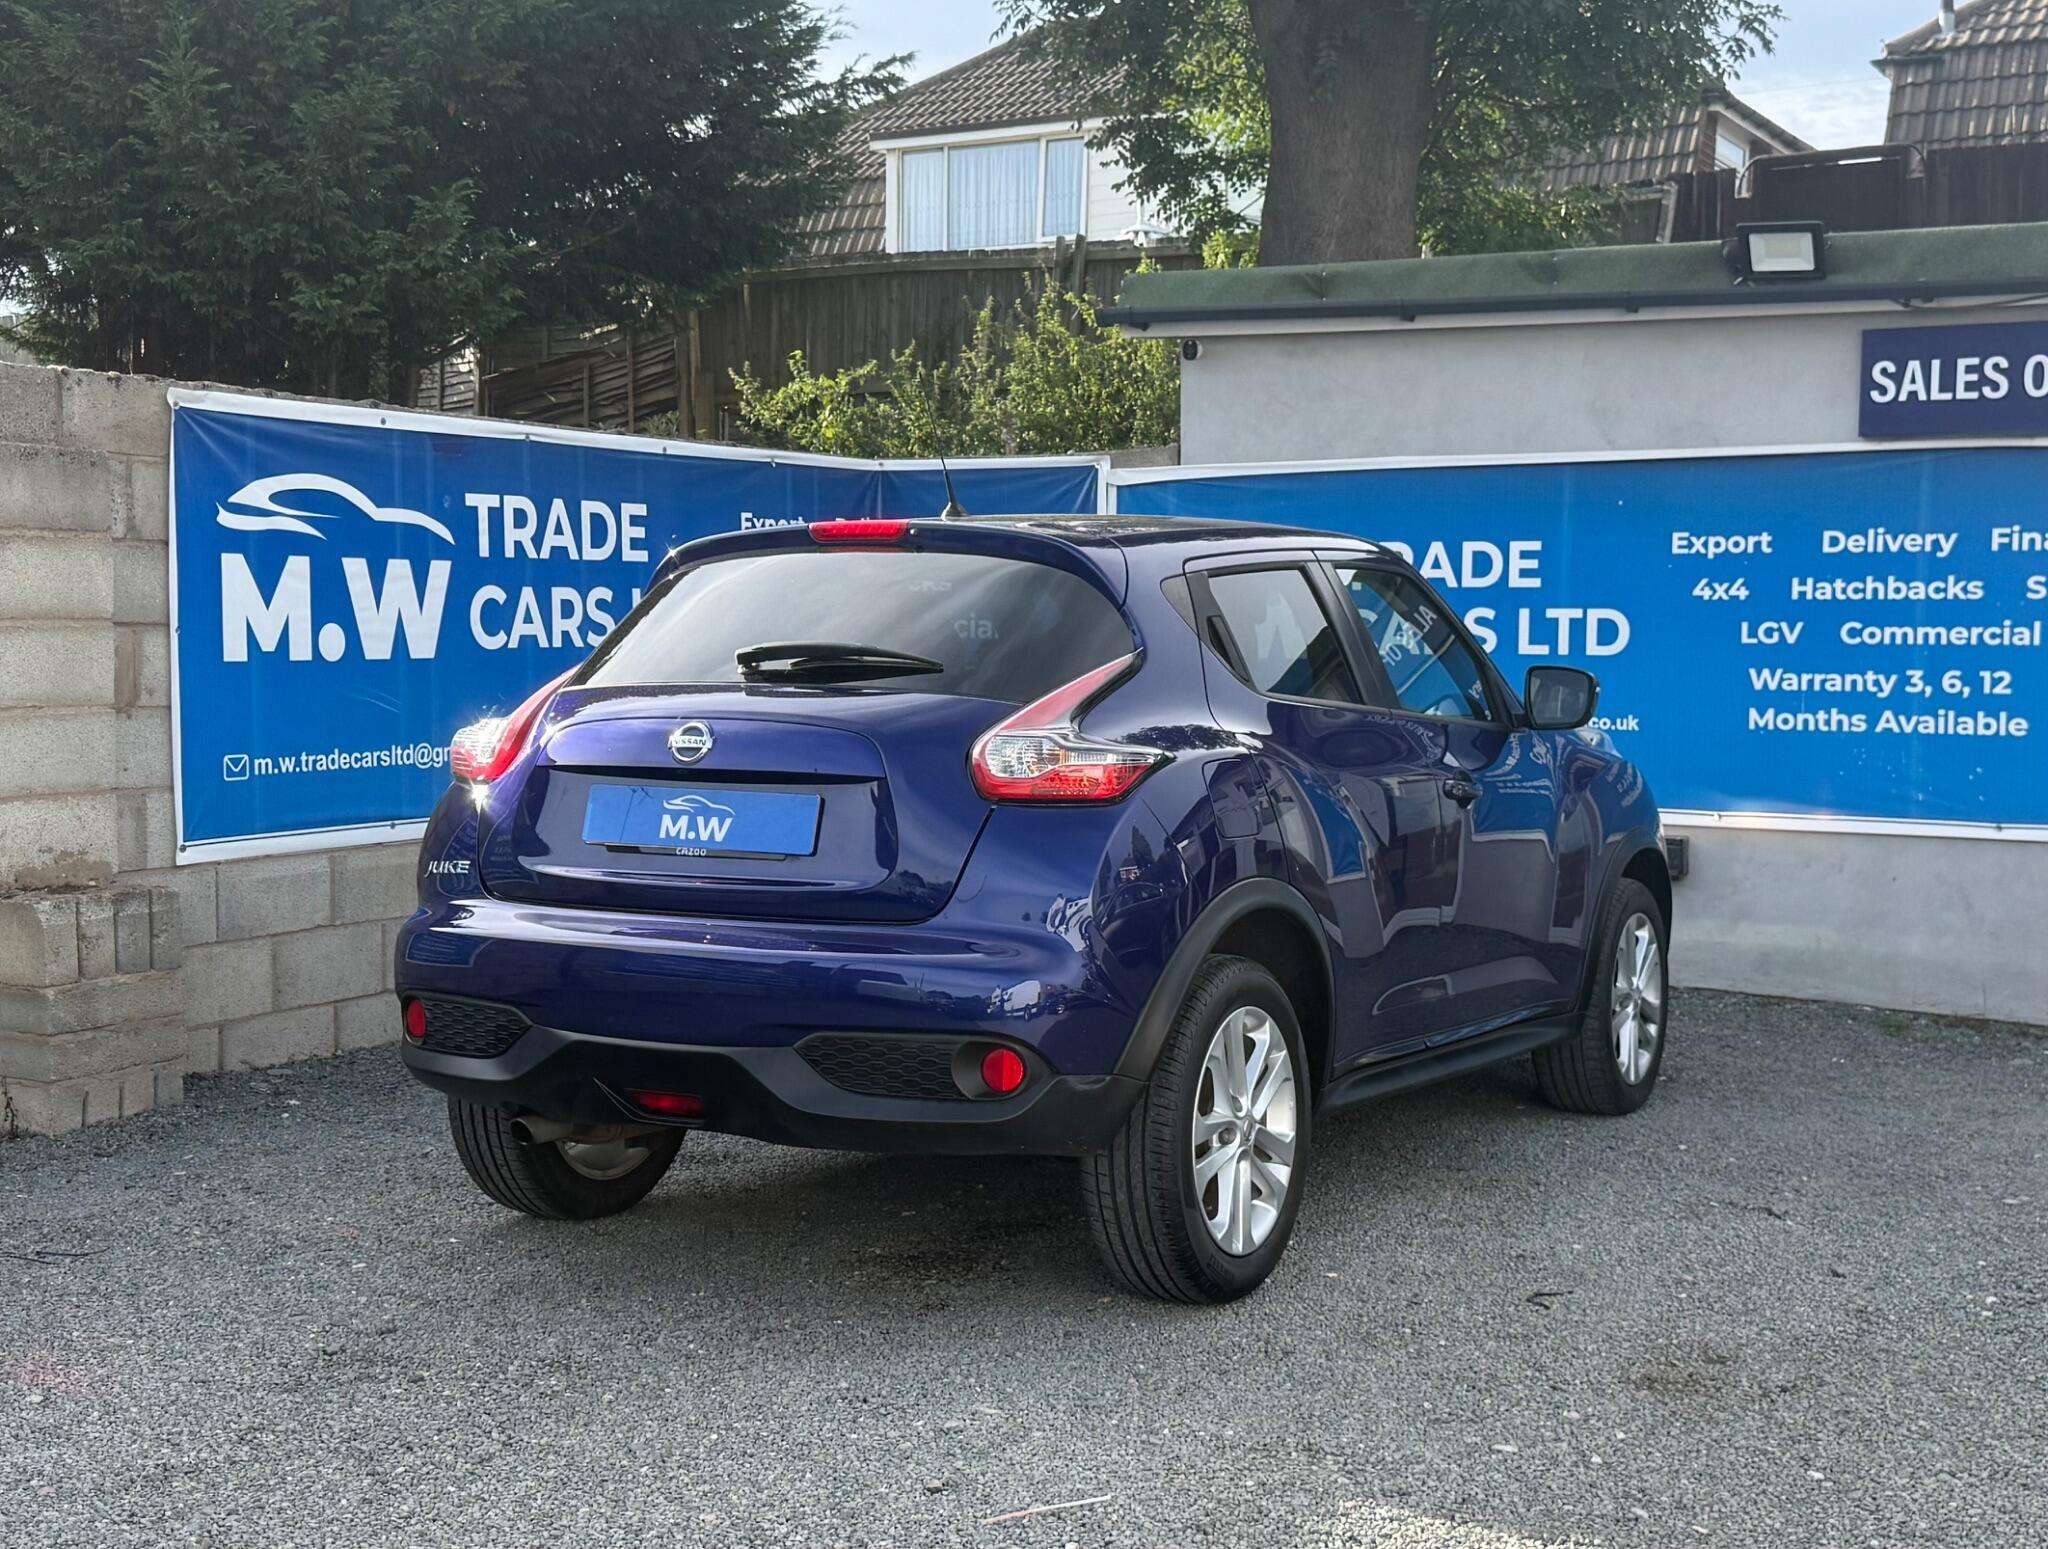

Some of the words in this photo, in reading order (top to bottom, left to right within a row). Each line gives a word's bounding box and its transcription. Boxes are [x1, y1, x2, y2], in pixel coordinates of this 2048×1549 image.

[1870, 356, 2010, 403] SALES
[465, 493, 648, 562] TRADE
[1671, 531, 1773, 559] Export
[1822, 528, 1958, 558] Delivery
[1379, 541, 1543, 589] ADE
[1692, 578, 1750, 601] 4x4
[1791, 576, 1984, 601] Hatchbacks
[220, 553, 452, 662] M.W
[470, 585, 616, 650] CARS
[1518, 608, 1631, 656] LTD
[1741, 621, 1804, 645] LGV
[1840, 620, 2042, 646] Commercial
[1749, 668, 1898, 698] Warranty
[1905, 670, 1933, 697] 3,
[1942, 671, 1970, 698] 6,
[1979, 671, 2013, 695] 12
[1749, 708, 1867, 733] Months
[1875, 710, 2029, 737] Available
[658, 814, 733, 843] M.W
[424, 860, 471, 878] JUKE
